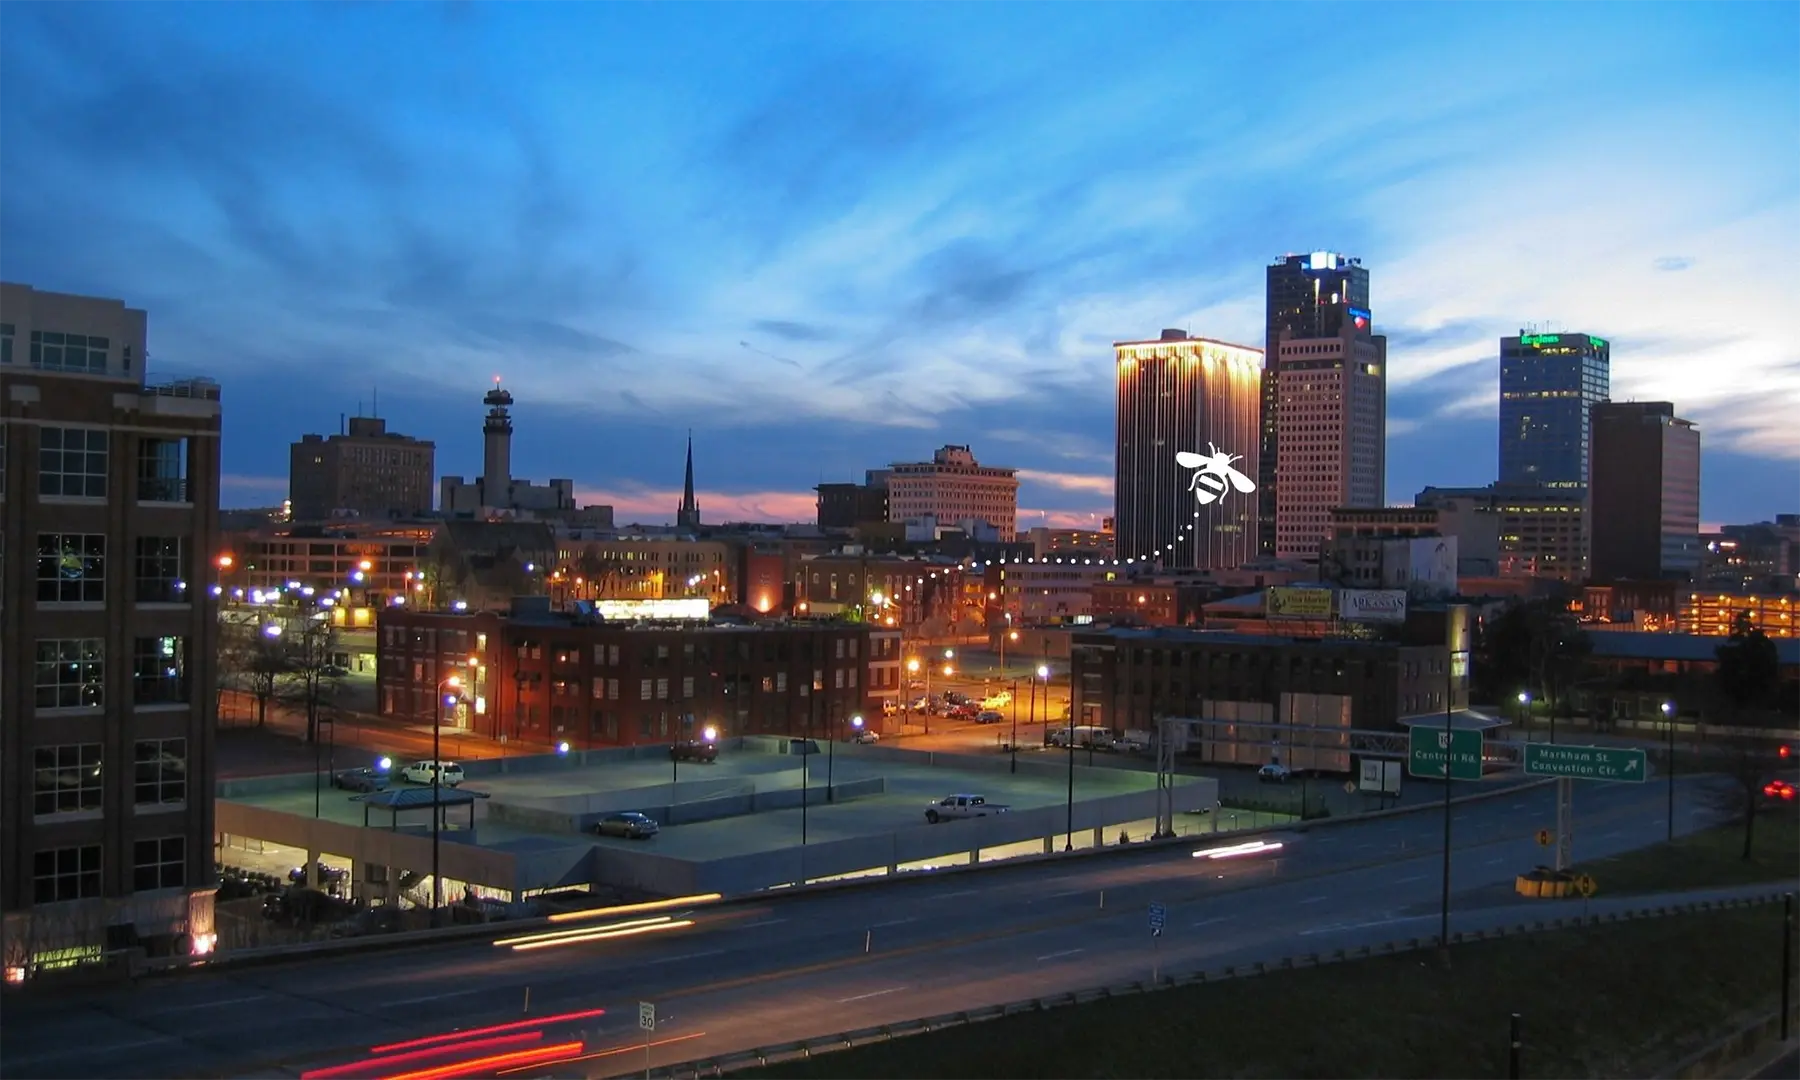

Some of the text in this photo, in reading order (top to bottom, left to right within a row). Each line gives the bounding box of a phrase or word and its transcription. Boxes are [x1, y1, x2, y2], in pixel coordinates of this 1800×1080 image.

[1539, 749, 1590, 761] Markham
[1531, 760, 1593, 774] Convention
[641, 1015, 653, 1028] 30
